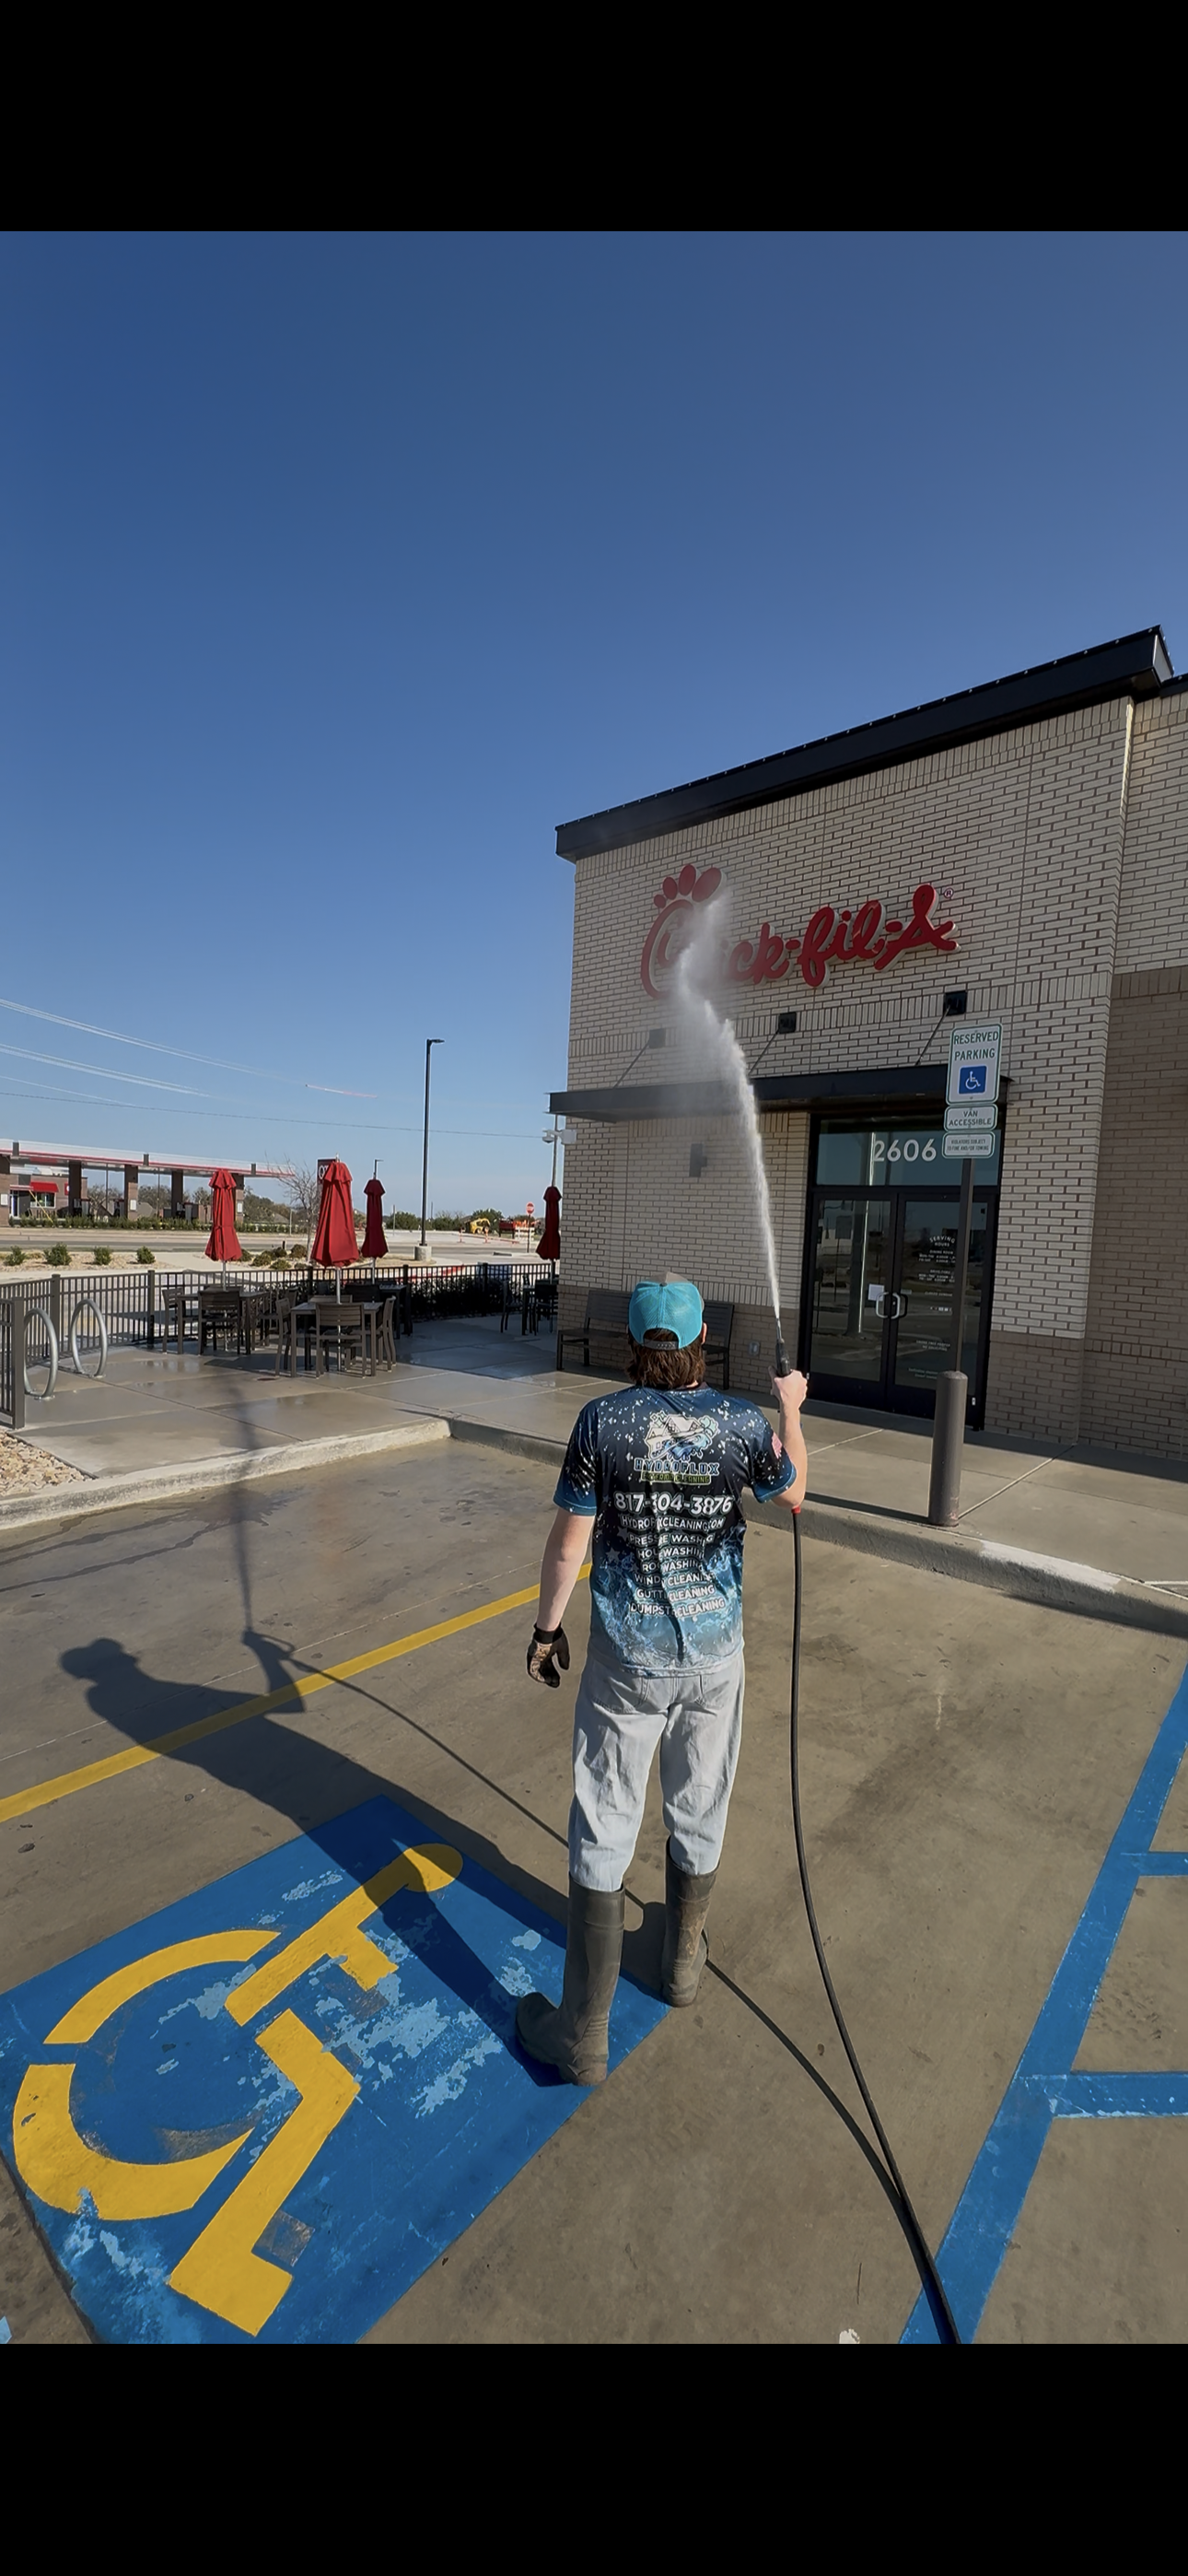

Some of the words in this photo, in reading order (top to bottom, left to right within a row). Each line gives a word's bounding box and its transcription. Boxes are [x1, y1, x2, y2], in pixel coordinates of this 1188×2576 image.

[641, 866, 960, 1000] Cick-fil-A
[953, 1031, 999, 1045] RESERVED
[954, 1048, 996, 1061] PARKING
[949, 1118, 992, 1126] ACCESSIBLE
[874, 1138, 937, 1162] 2606
[929, 1235, 955, 1244] SERVING
[635, 1458, 719, 1476] HYDROFLUX
[672, 1535, 715, 1547] WASHIG
[636, 1588, 667, 1599] GUTT
[669, 1586, 715, 1601] CLEANING
[677, 1598, 725, 1616] CLEANING
